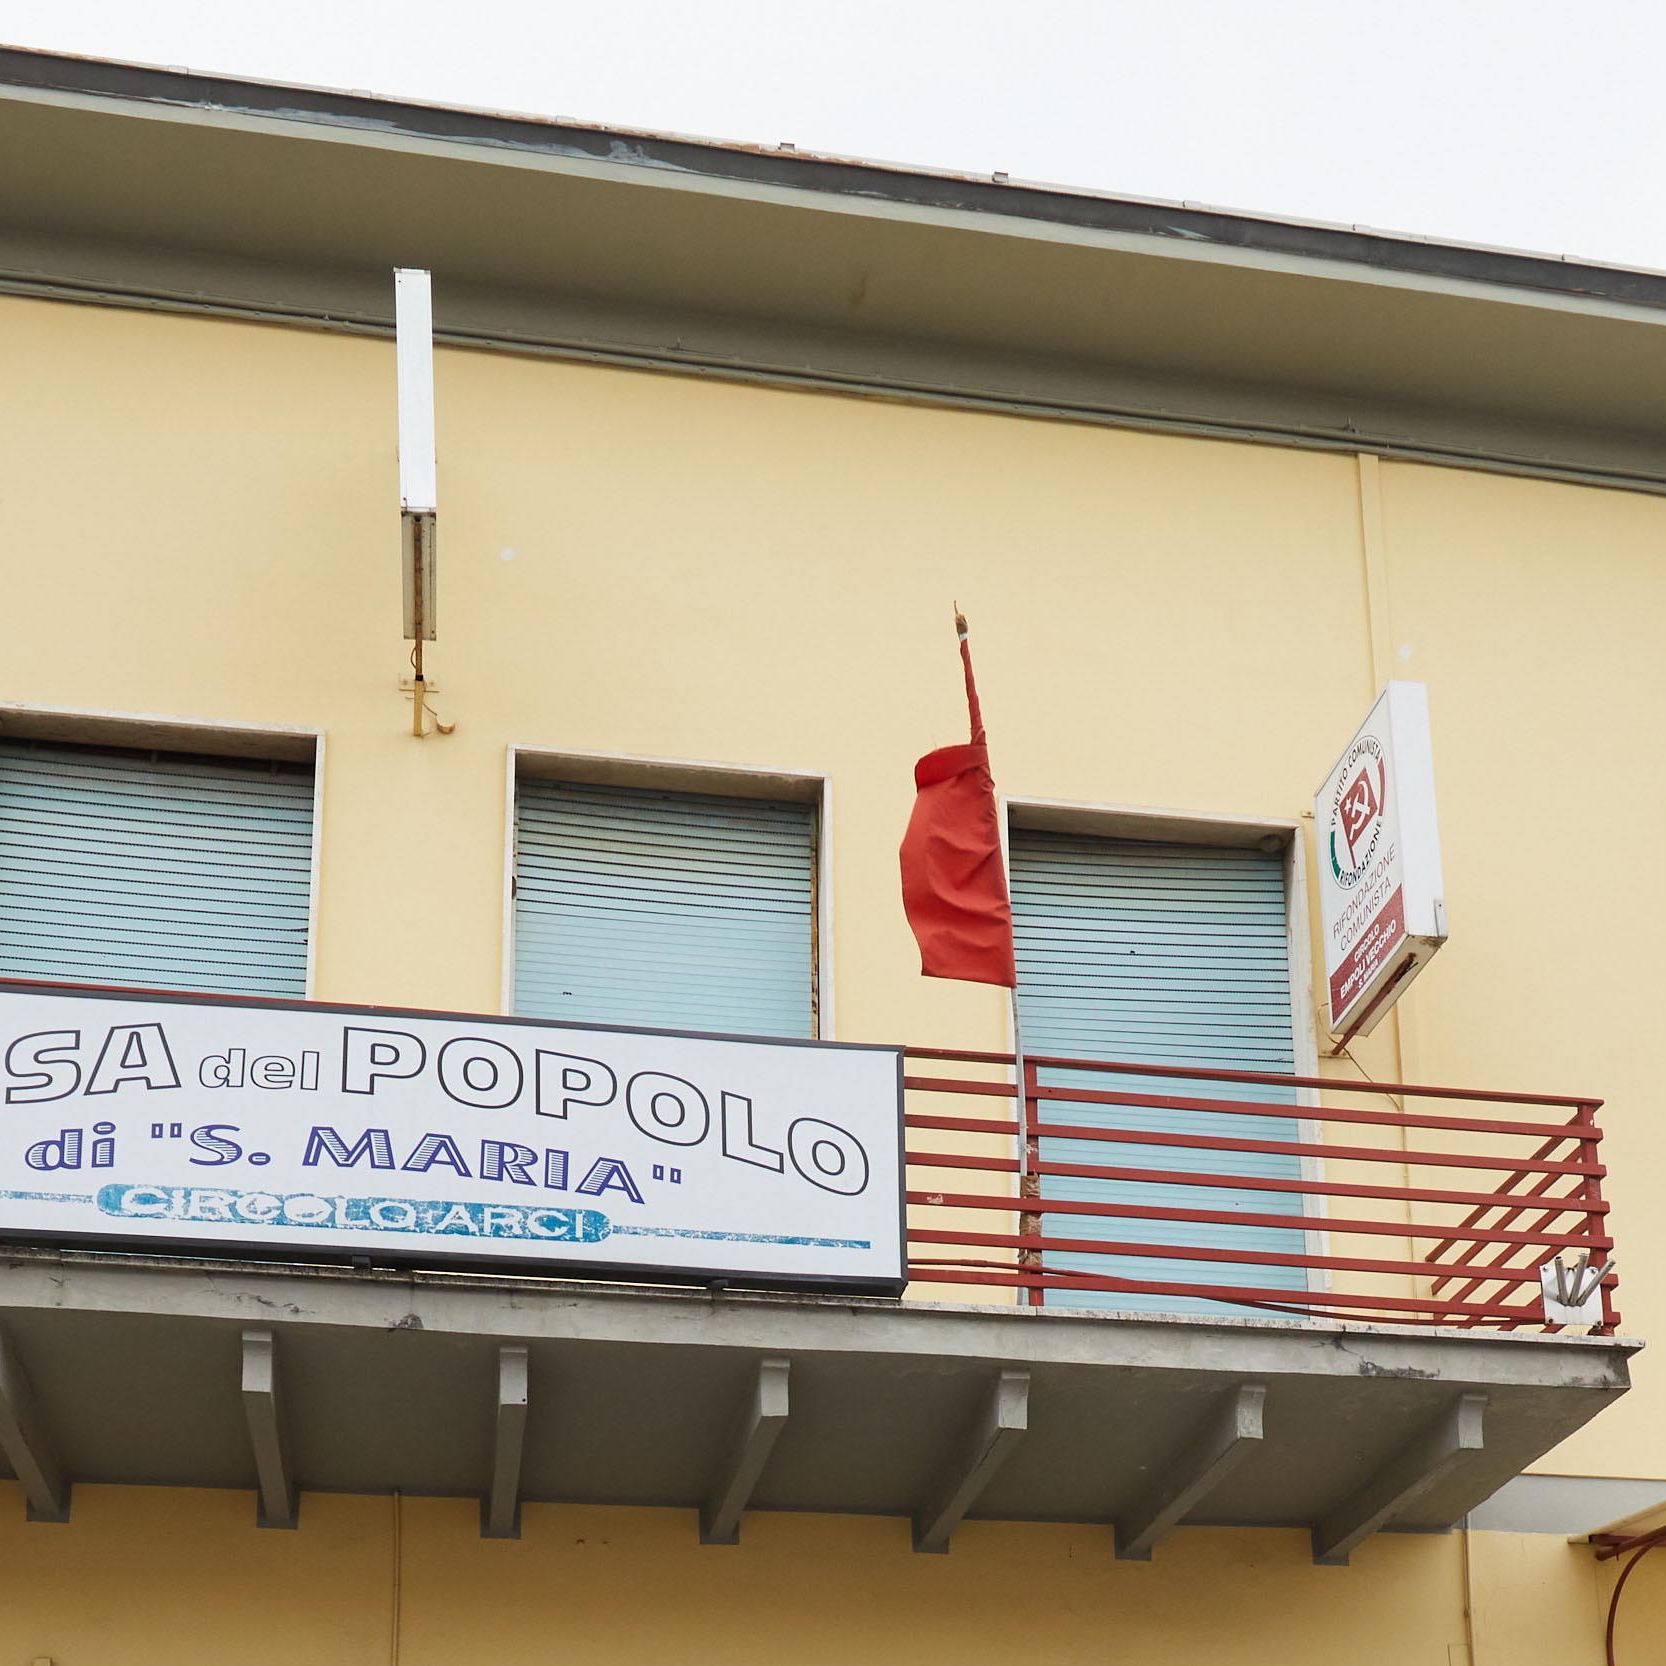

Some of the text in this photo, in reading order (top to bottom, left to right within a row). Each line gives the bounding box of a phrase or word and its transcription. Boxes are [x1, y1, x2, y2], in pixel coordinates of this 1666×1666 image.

[1330, 739, 1381, 827] PARTITO COMUNISTA
[1332, 842, 1396, 940] RIFONDAZIONE
[1339, 818, 1383, 887] RIFONDAZIONE
[1340, 876, 1392, 951] COMUNISTA
[1353, 923, 1380, 962] CIRCOLO
[1339, 918, 1397, 1000] EMPOLI VECCHIO
[197, 1047, 321, 1091] del
[340, 1025, 871, 1197] POPOLO
[24, 1120, 683, 1205] di "S. MARIA"
[120, 1185, 585, 1240] CIRCOLO ARCI
